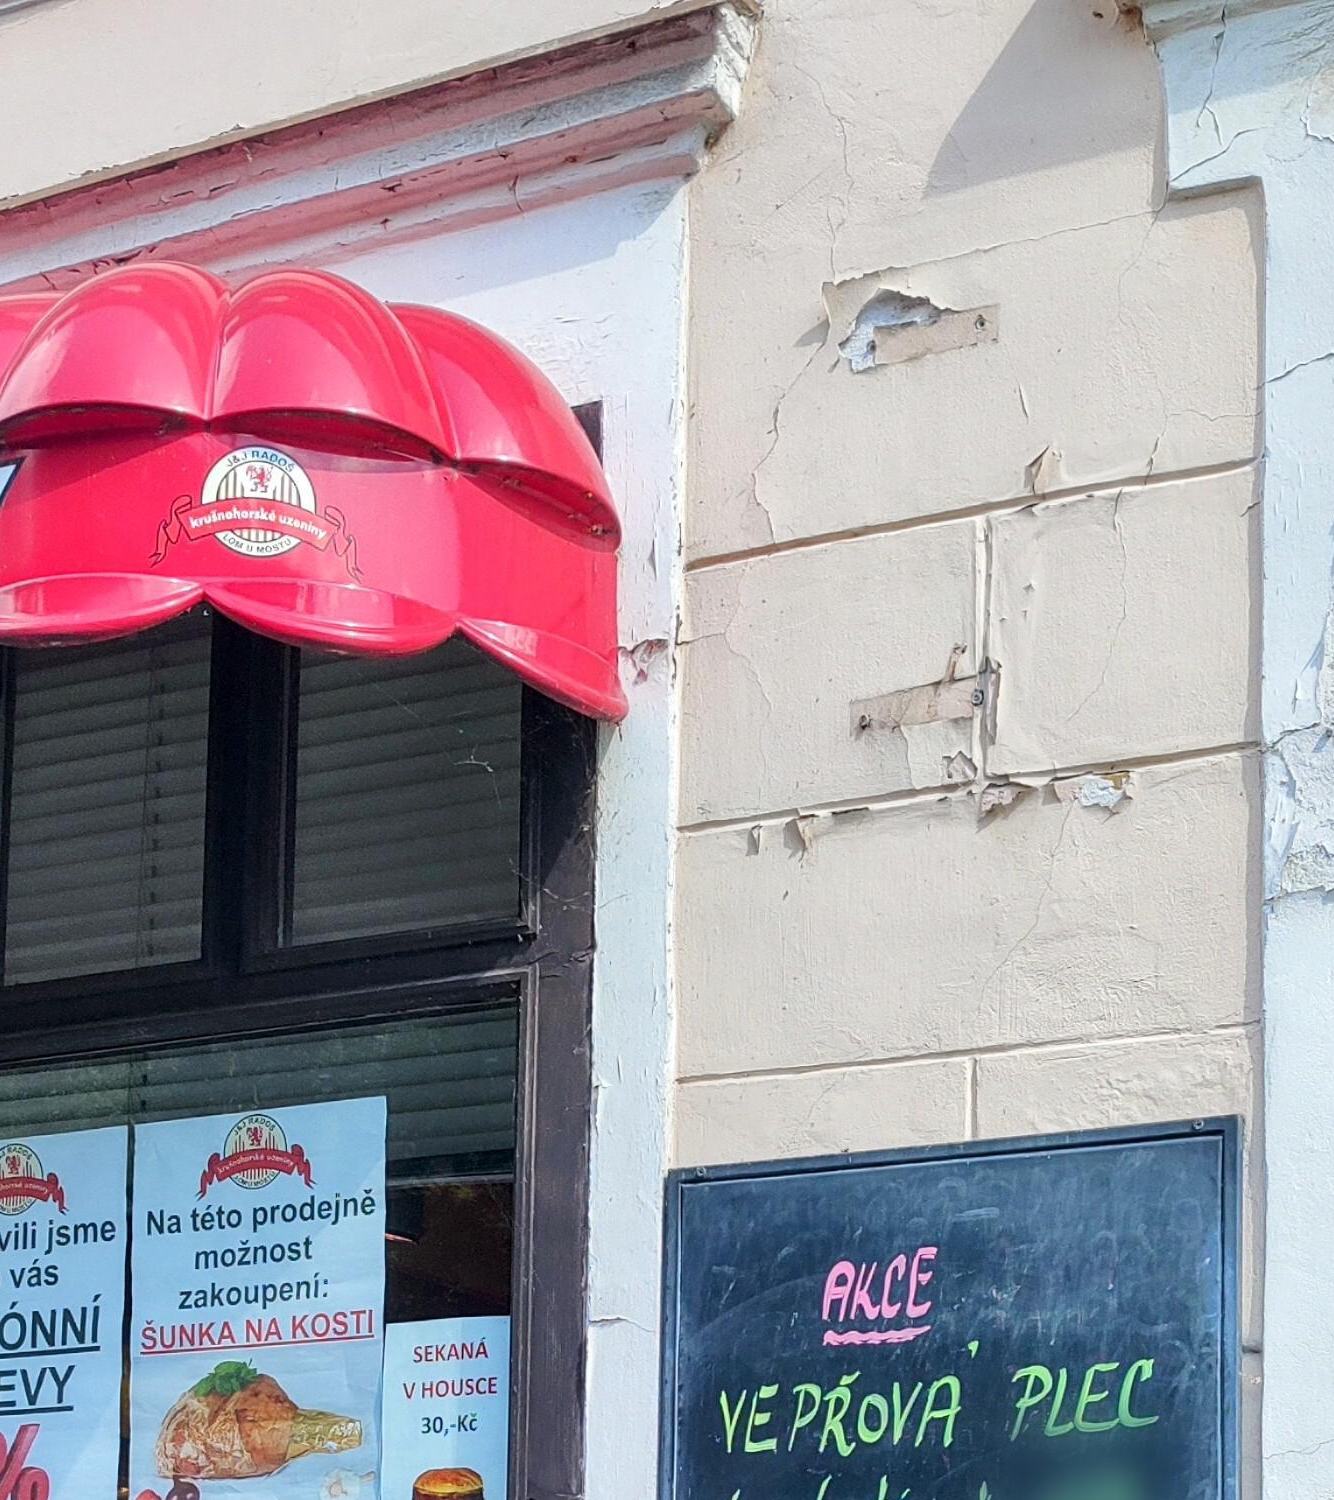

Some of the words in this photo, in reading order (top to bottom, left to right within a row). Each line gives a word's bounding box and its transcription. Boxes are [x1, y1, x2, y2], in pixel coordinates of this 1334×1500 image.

[189, 507, 276, 528] krušnohorské
[280, 513, 327, 539] uzeniny
[147, 1209, 182, 1235] Na
[190, 1205, 242, 1232] této
[253, 1189, 376, 1232] prodejně
[45, 1220, 116, 1255] jsme
[195, 1235, 313, 1270] možnost
[10, 1259, 59, 1288] vás
[179, 1272, 329, 1309] zakoupení:
[821, 1246, 938, 1322] AKCE
[141, 1320, 235, 1350] ŠUNKA
[246, 1317, 282, 1343] NA
[291, 1309, 373, 1339] KOSTI
[413, 1337, 489, 1363] SEKANÁ
[403, 1382, 416, 1400] V
[422, 1376, 498, 1399] HOUSCE
[1010, 1358, 1160, 1442] PLEC
[421, 1413, 478, 1436] 30,-Kč
